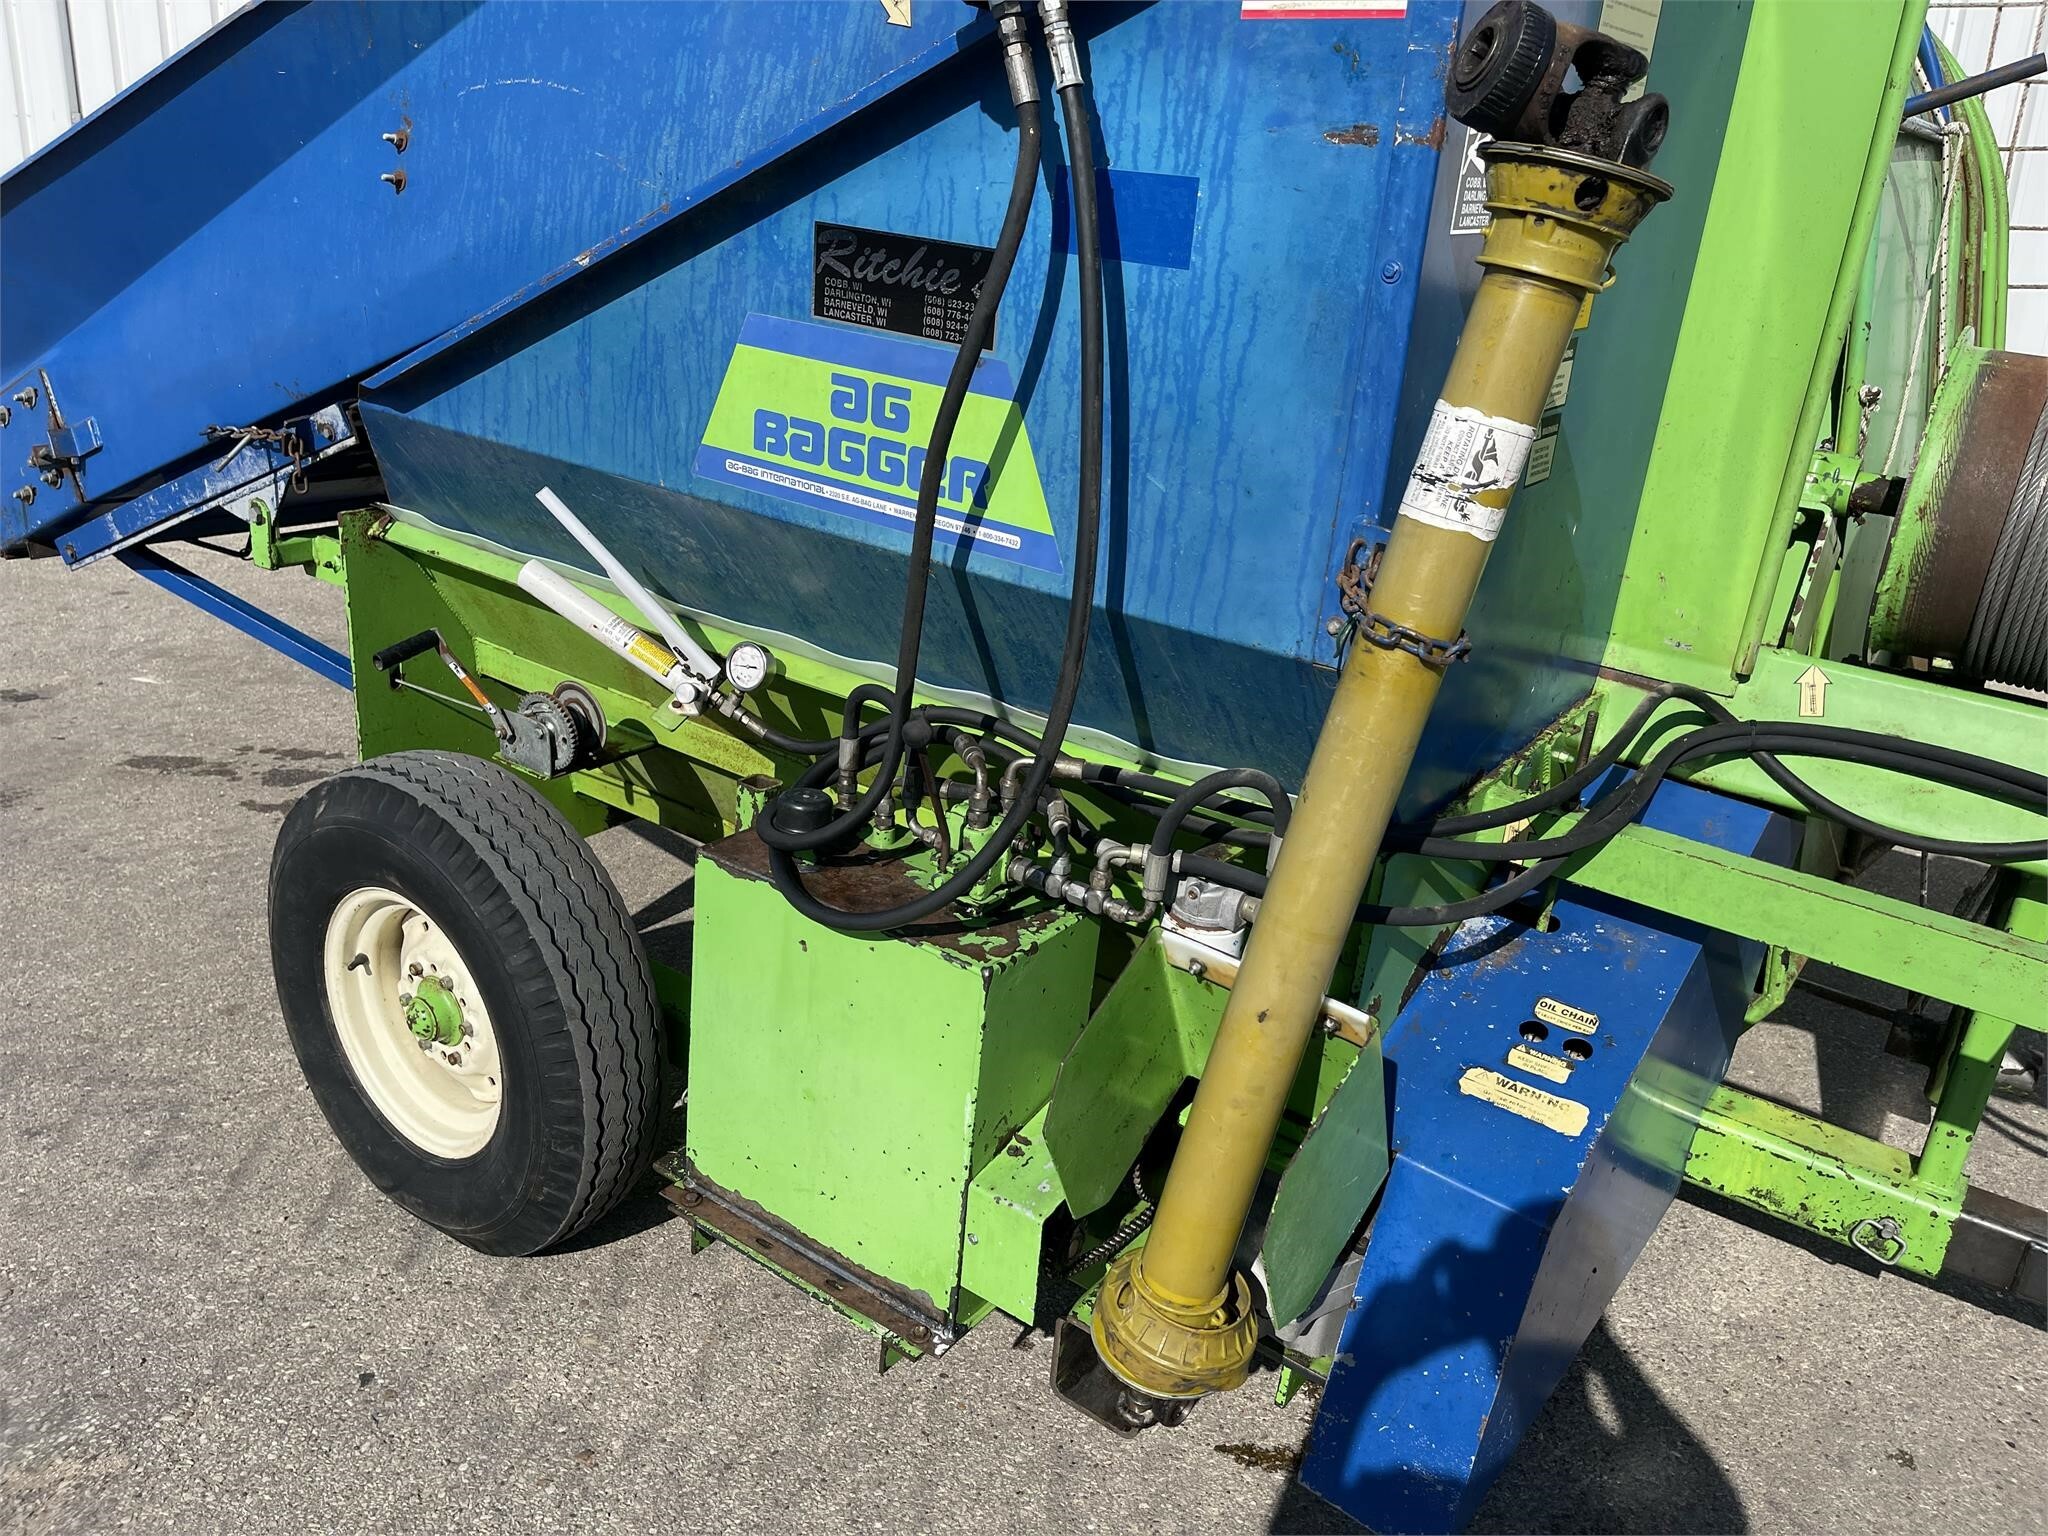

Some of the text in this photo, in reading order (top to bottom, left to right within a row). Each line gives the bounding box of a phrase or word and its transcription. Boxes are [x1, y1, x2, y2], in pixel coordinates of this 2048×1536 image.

[1464, 190, 1487, 201] DARLING
[852, 281, 862, 291] WI
[881, 298, 892, 307] WI
[877, 307, 888, 317] WI
[924, 306, 944, 318] (608)
[876, 316, 886, 327] WI
[923, 316, 943, 328] (608)
[923, 327, 942, 339] (608)
[1442, 440, 1453, 462] KEEP
[1540, 1001, 1597, 1026] OIL CHAIN
[1529, 1049, 1567, 1068] WARNING
